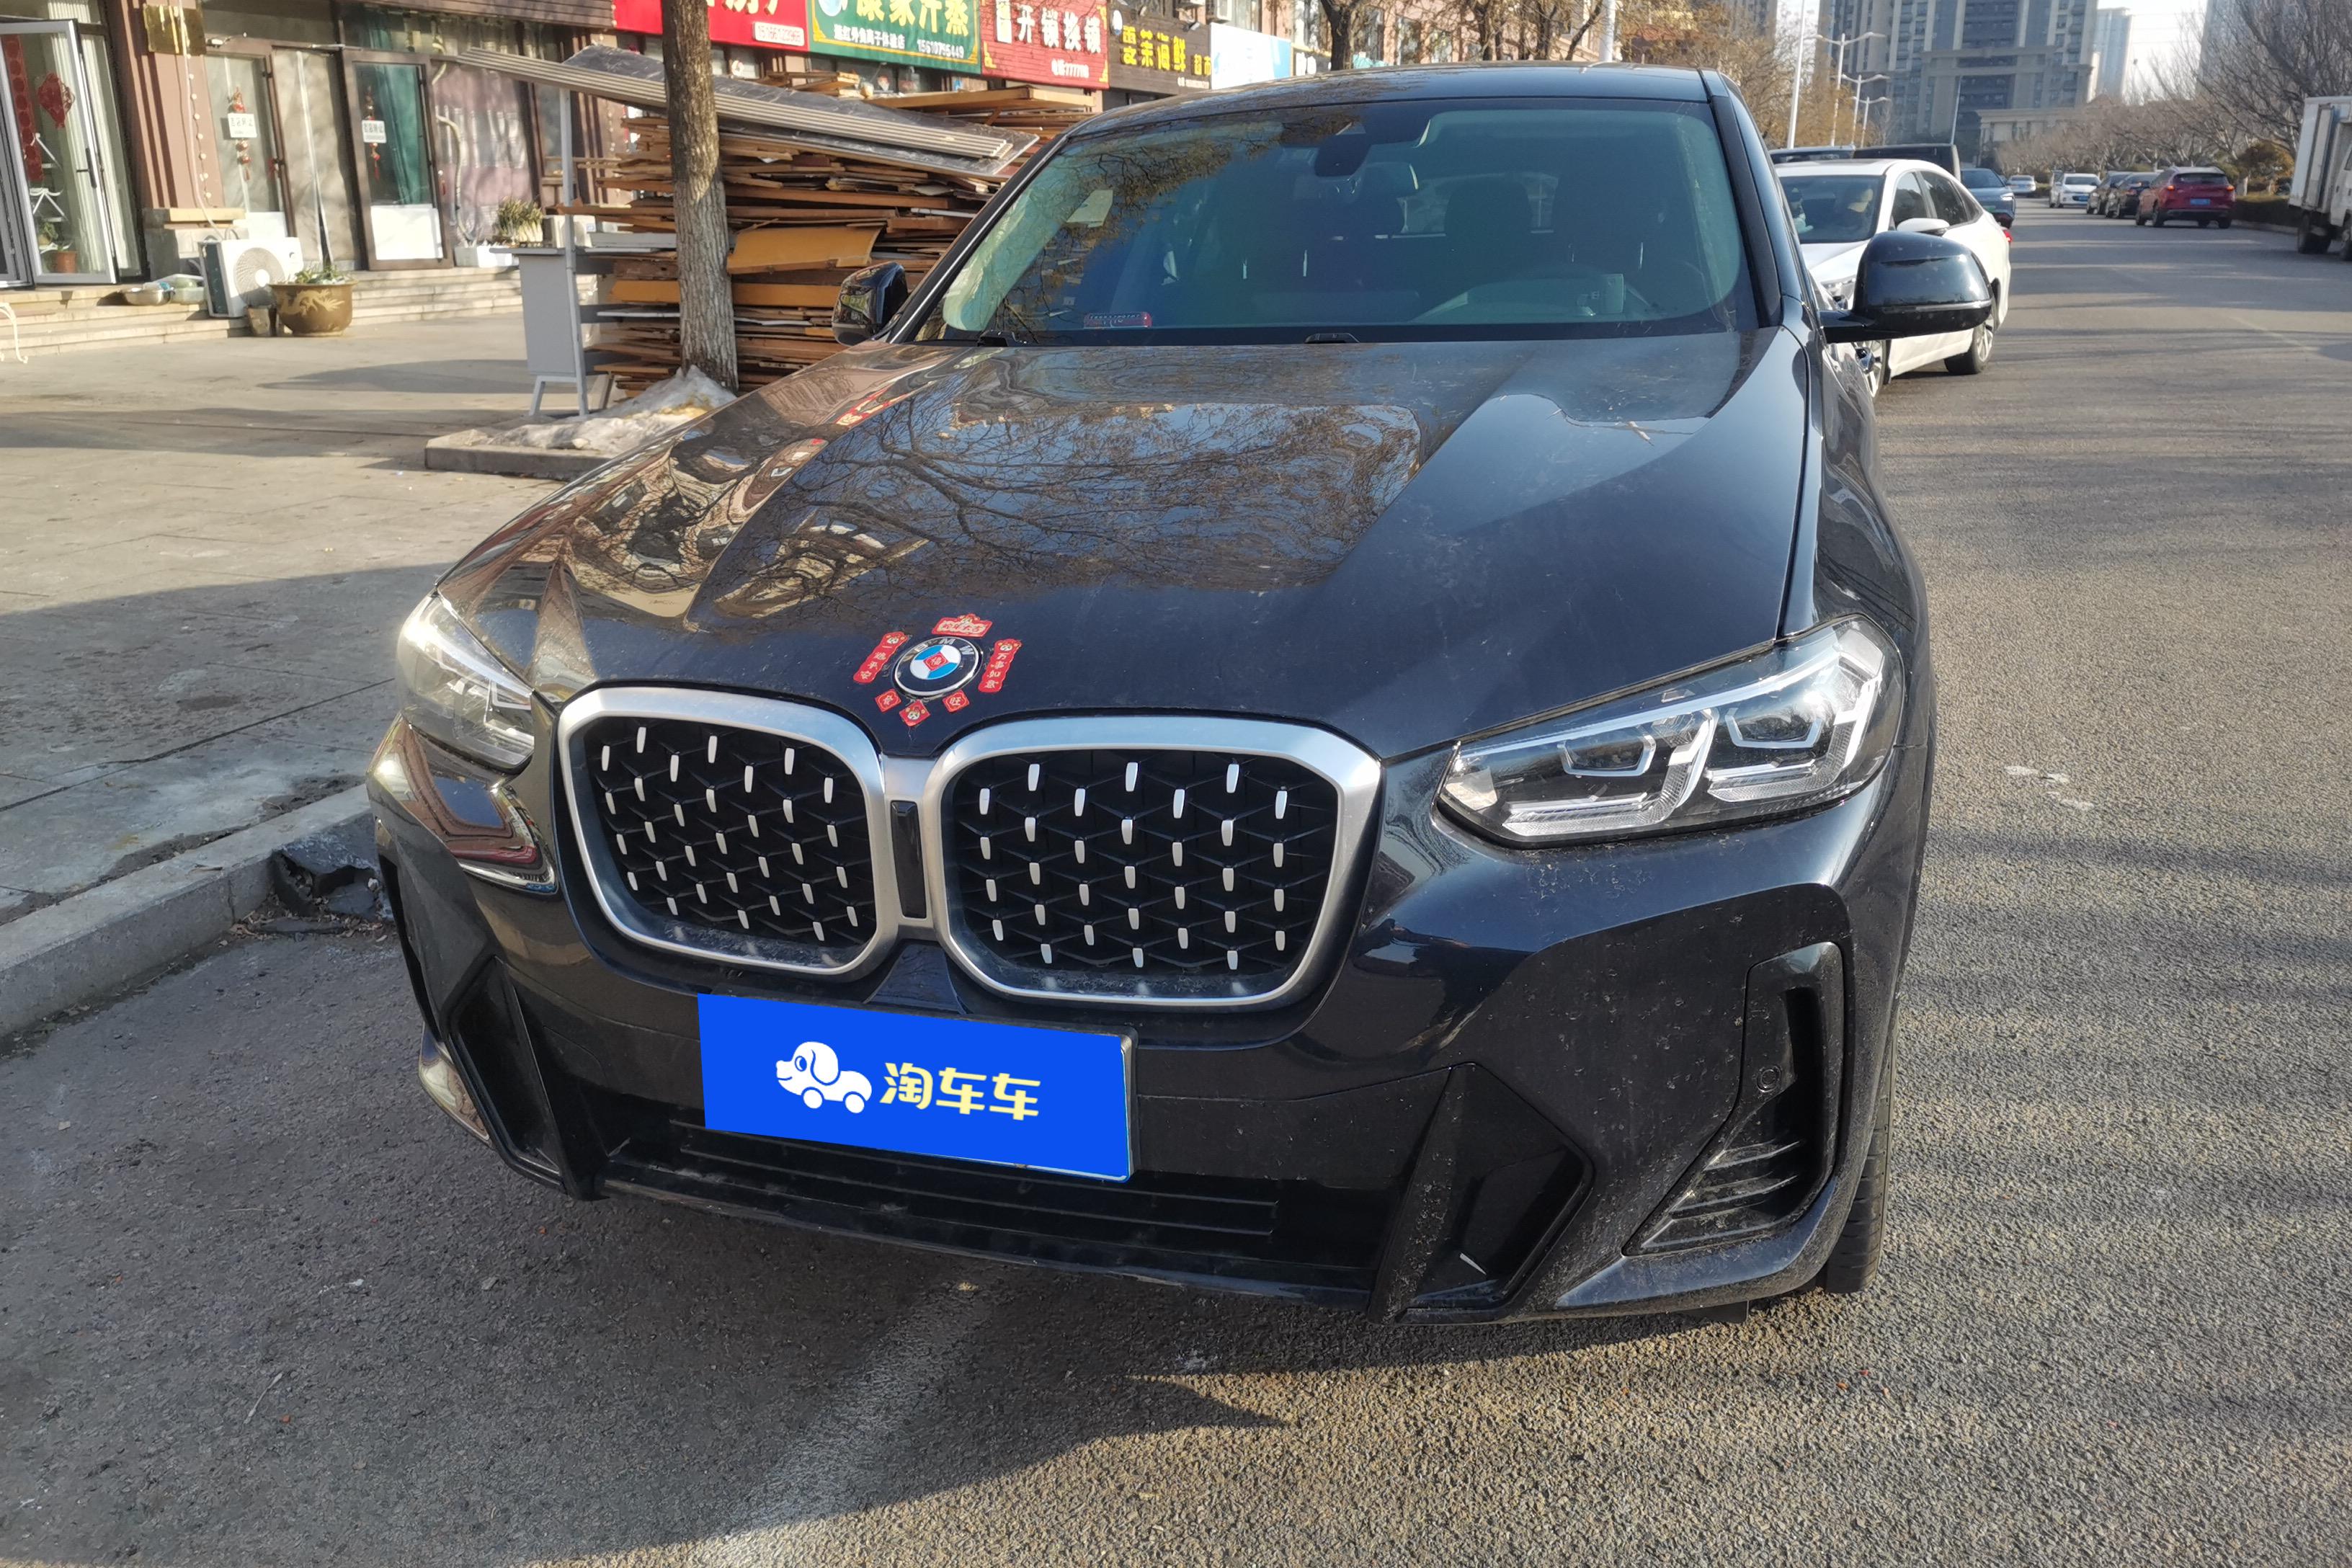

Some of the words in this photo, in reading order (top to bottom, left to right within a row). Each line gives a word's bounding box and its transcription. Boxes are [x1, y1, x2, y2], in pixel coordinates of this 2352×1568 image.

[914, 638, 975, 655] BMW
[984, 653, 1010, 689] 万事如意
